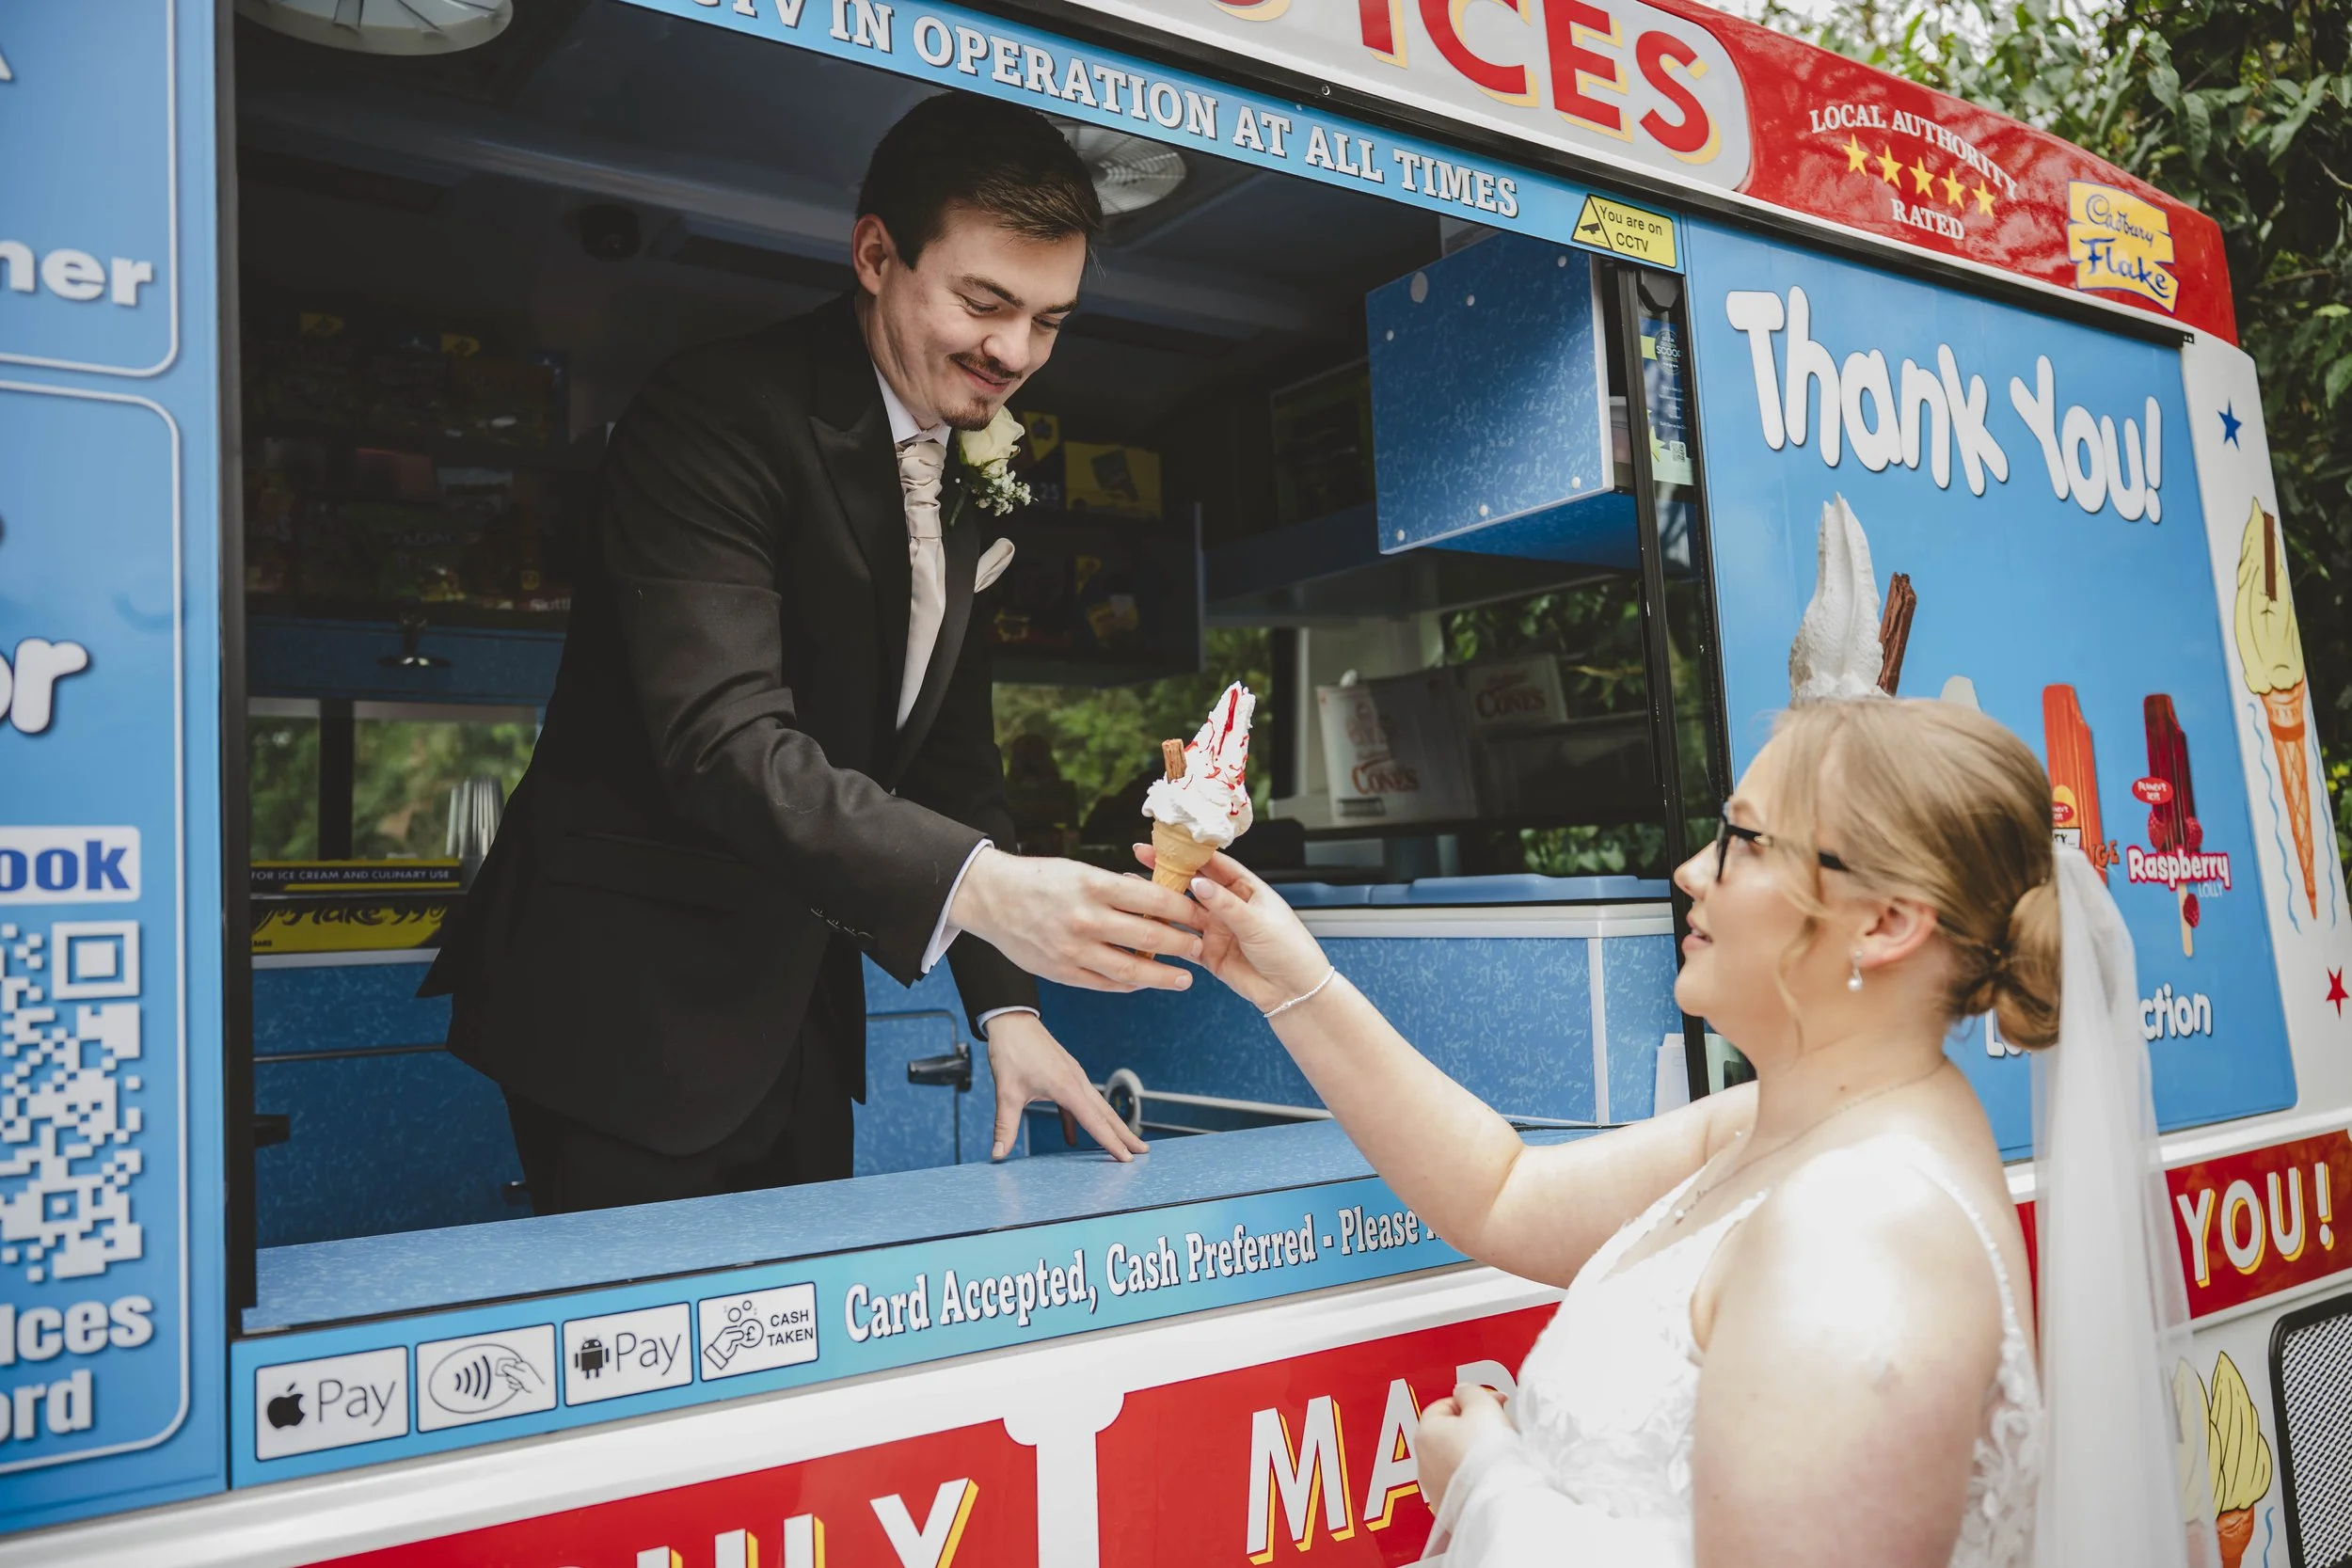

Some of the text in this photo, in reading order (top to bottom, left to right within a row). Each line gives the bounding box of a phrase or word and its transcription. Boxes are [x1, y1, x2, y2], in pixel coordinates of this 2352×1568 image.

[830, 0, 895, 54] IN
[913, 16, 1217, 140] OPERATION
[1232, 106, 1292, 158] AT
[1305, 126, 1385, 184] ALL
[1393, 148, 1519, 218] TIMES
[1810, 104, 2017, 200] LOCAL AUTHORITY
[1600, 204, 1662, 236] You are on
[1615, 231, 1649, 253] CCTV
[1890, 198, 1964, 240] RATED
[2086, 194, 2153, 246] Cadbury
[2079, 237, 2170, 298] Flake
[1725, 285, 2162, 524] Thank You!
[0, 637, 88, 735] r
[278, 870, 294, 879] ICE
[299, 870, 339, 879] CREAM
[343, 870, 369, 879] AND
[372, 870, 426, 879] CULINARY
[429, 870, 450, 879] USE
[2129, 847, 2230, 889] Raspberry
[2177, 1162, 2334, 1289] YOU!
[845, 1205, 1419, 1342] Card Accepted, Cash Preferred - Please
[767, 1327, 814, 1346] TAKEN
[771, 1309, 809, 1327] CASH
[615, 1332, 682, 1375] Pay
[0, 1370, 92, 1442] rd
[317, 1379, 396, 1427] Pay
